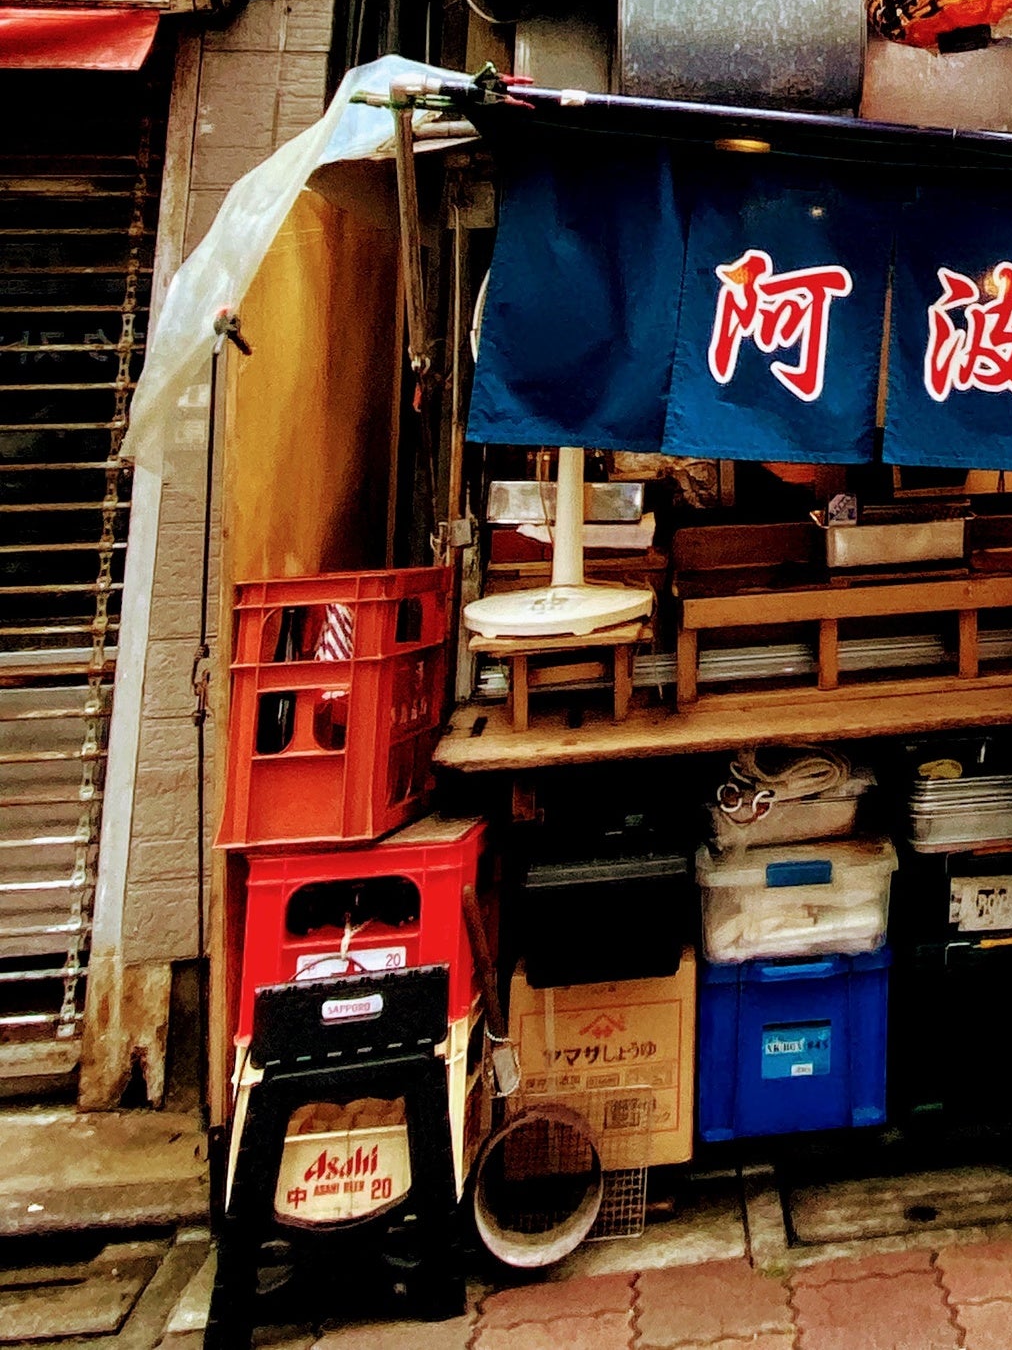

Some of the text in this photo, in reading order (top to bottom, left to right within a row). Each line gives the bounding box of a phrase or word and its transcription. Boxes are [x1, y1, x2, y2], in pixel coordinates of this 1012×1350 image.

[385, 953, 401, 967] 20
[328, 1002, 371, 1015] SAPPORO
[304, 1144, 378, 1182] Asahi
[286, 1187, 307, 1209] 中
[371, 1178, 392, 1200] 20
